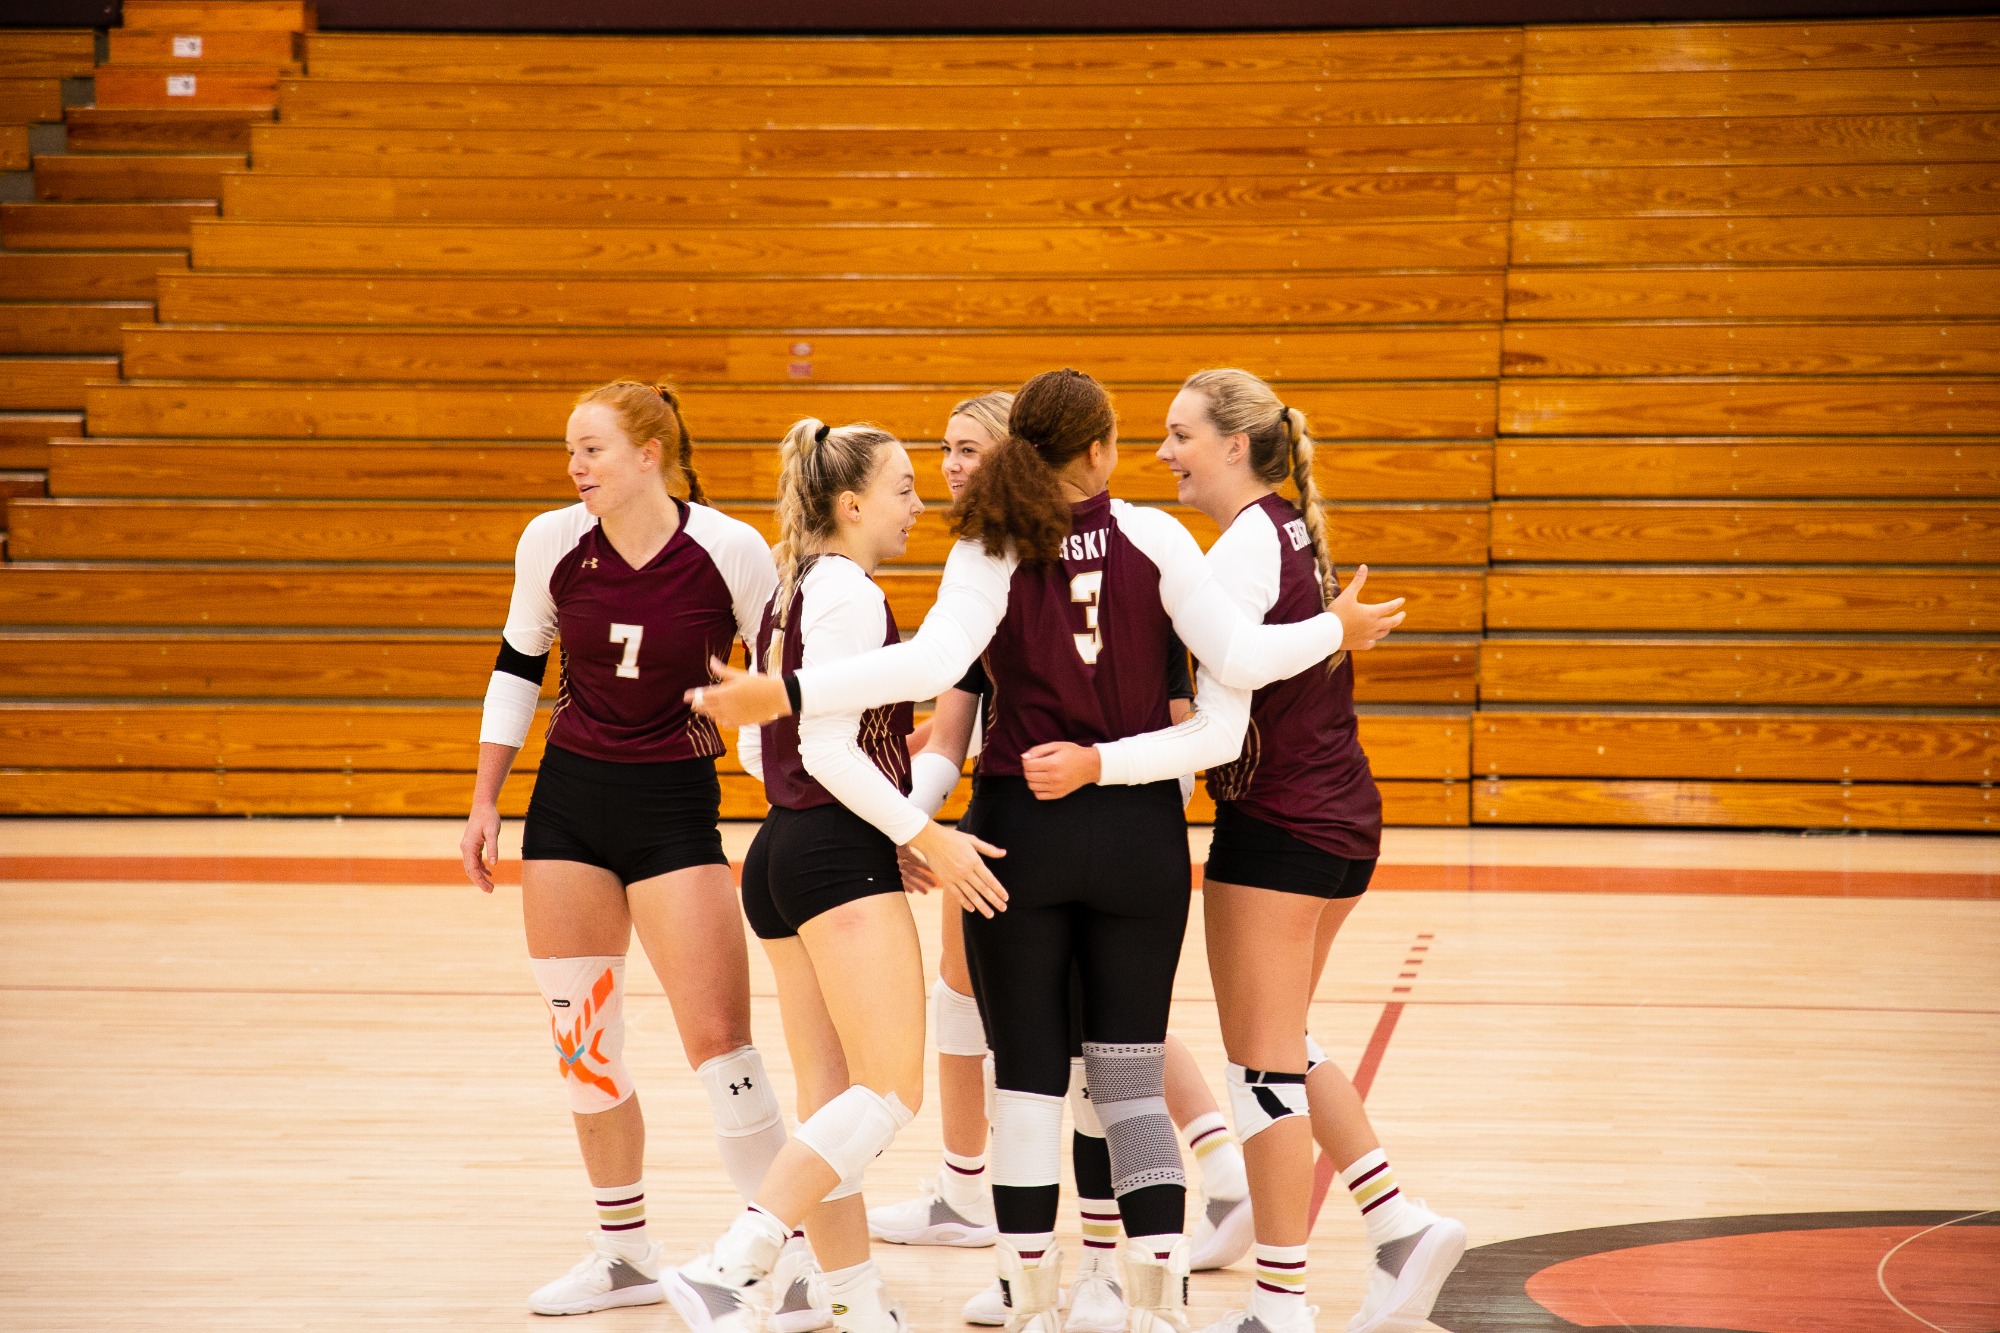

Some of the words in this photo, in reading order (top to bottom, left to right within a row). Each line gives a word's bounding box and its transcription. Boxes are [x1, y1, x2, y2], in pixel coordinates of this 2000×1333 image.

[1059, 528, 1109, 560] RSKI
[1070, 570, 1103, 664] 3
[609, 623, 644, 679] 7
